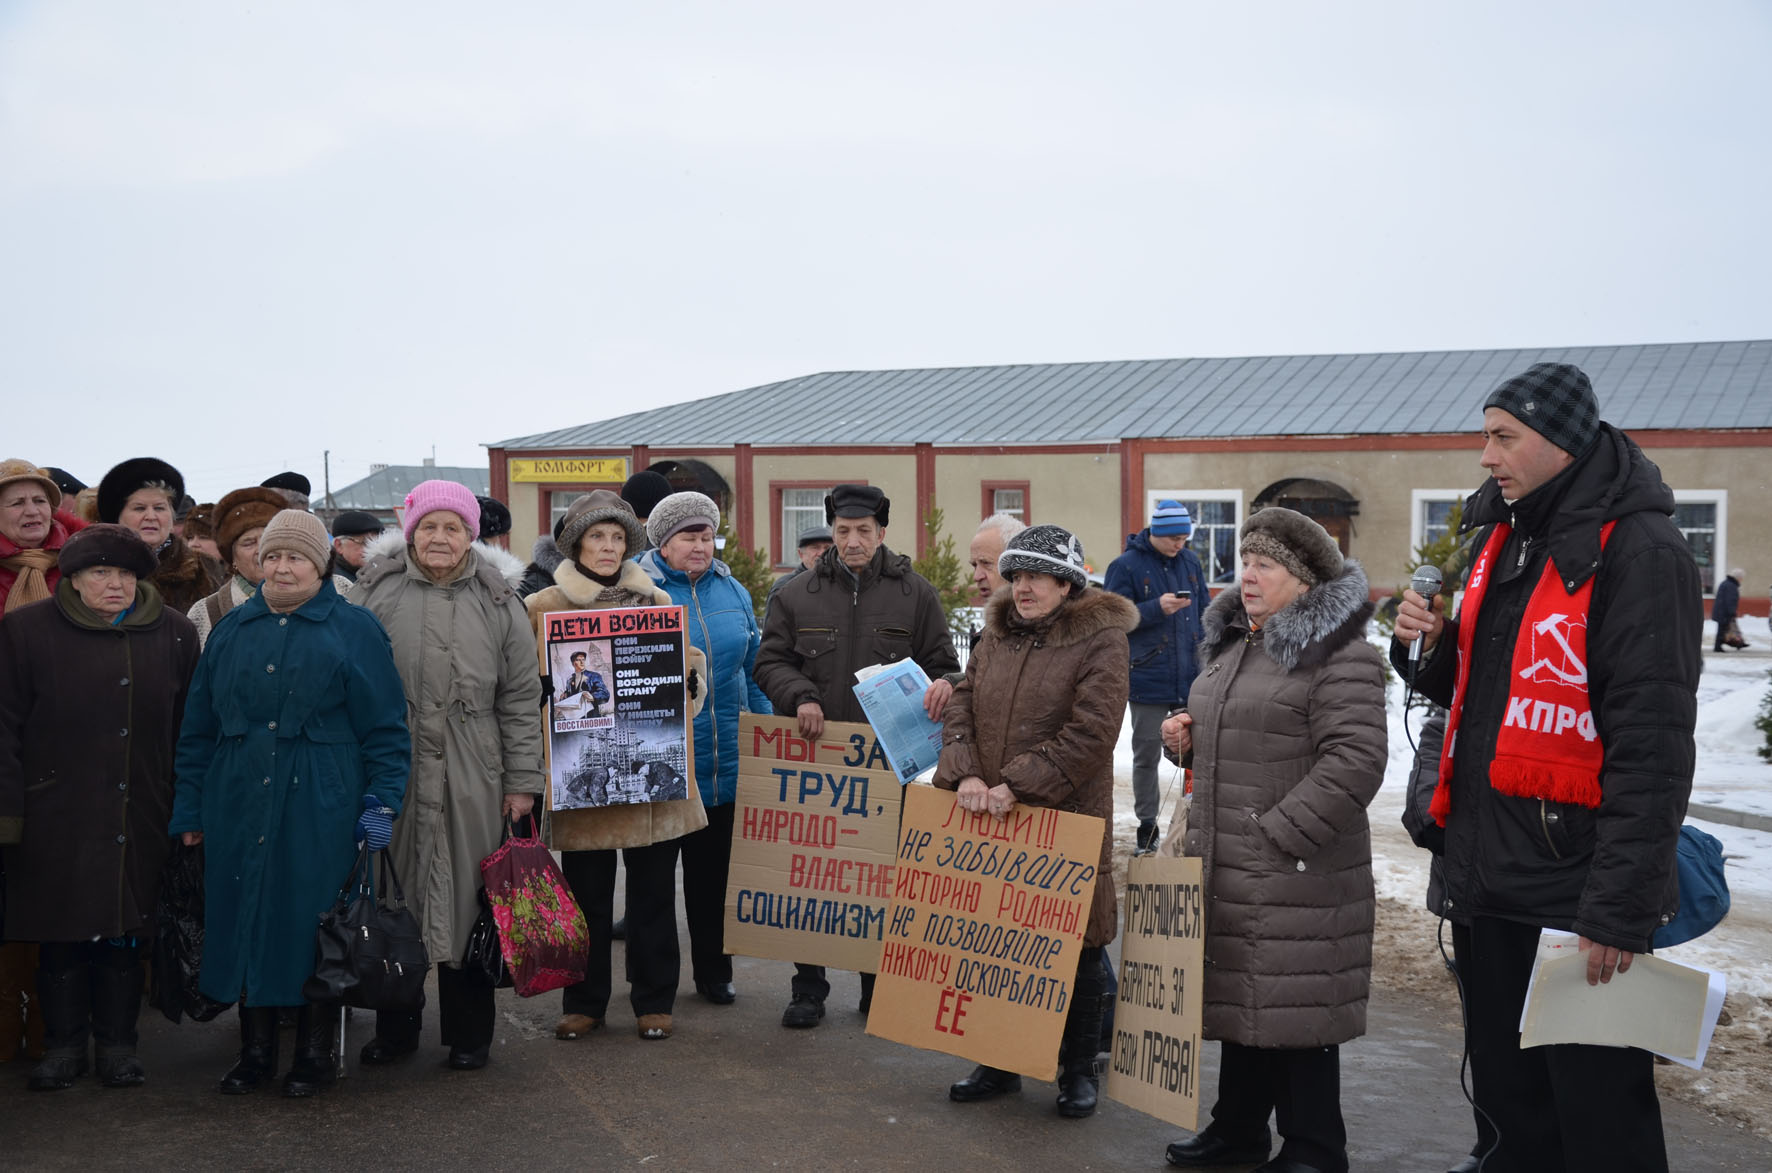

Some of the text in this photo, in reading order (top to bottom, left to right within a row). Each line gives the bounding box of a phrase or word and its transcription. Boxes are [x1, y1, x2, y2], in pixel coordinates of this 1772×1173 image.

[534, 460, 605, 473] КОМФОРТ
[549, 609, 680, 641] ДЕТИ ВОЙНЫ
[614, 637, 638, 646] ОНИ
[615, 644, 674, 655] ПЕРЕЖИЛИ
[615, 654, 653, 664] ВОЙНУ
[616, 669, 640, 678] ОНИ
[616, 675, 682, 688] ВОЗРОДИЛИ
[617, 686, 657, 697] СТРАНУ
[618, 701, 641, 711] ОНИ
[628, 709, 675, 719] НИЩЕТЫ
[1504, 696, 1598, 742] КПРФ
[556, 718, 613, 731] ВОССТАНОВИМ!
[772, 768, 884, 818] ТРУД,
[742, 806, 859, 849] НАРОДО-
[789, 853, 897, 899] ВЛАСТИЕ
[895, 866, 982, 914] ИСТОРИЮ
[736, 889, 886, 941] СОЦИАЛИЗМ
[1127, 883, 1200, 940] ТРУДЯЩИЕСЯ
[881, 942, 1068, 1013] НИКОМУ ОСКОРБЛЯТЬ
[1121, 959, 1184, 1016] БОРИТЕСЬ ЗА
[1114, 1030, 1196, 1099] СВОИ ПРАВА!
